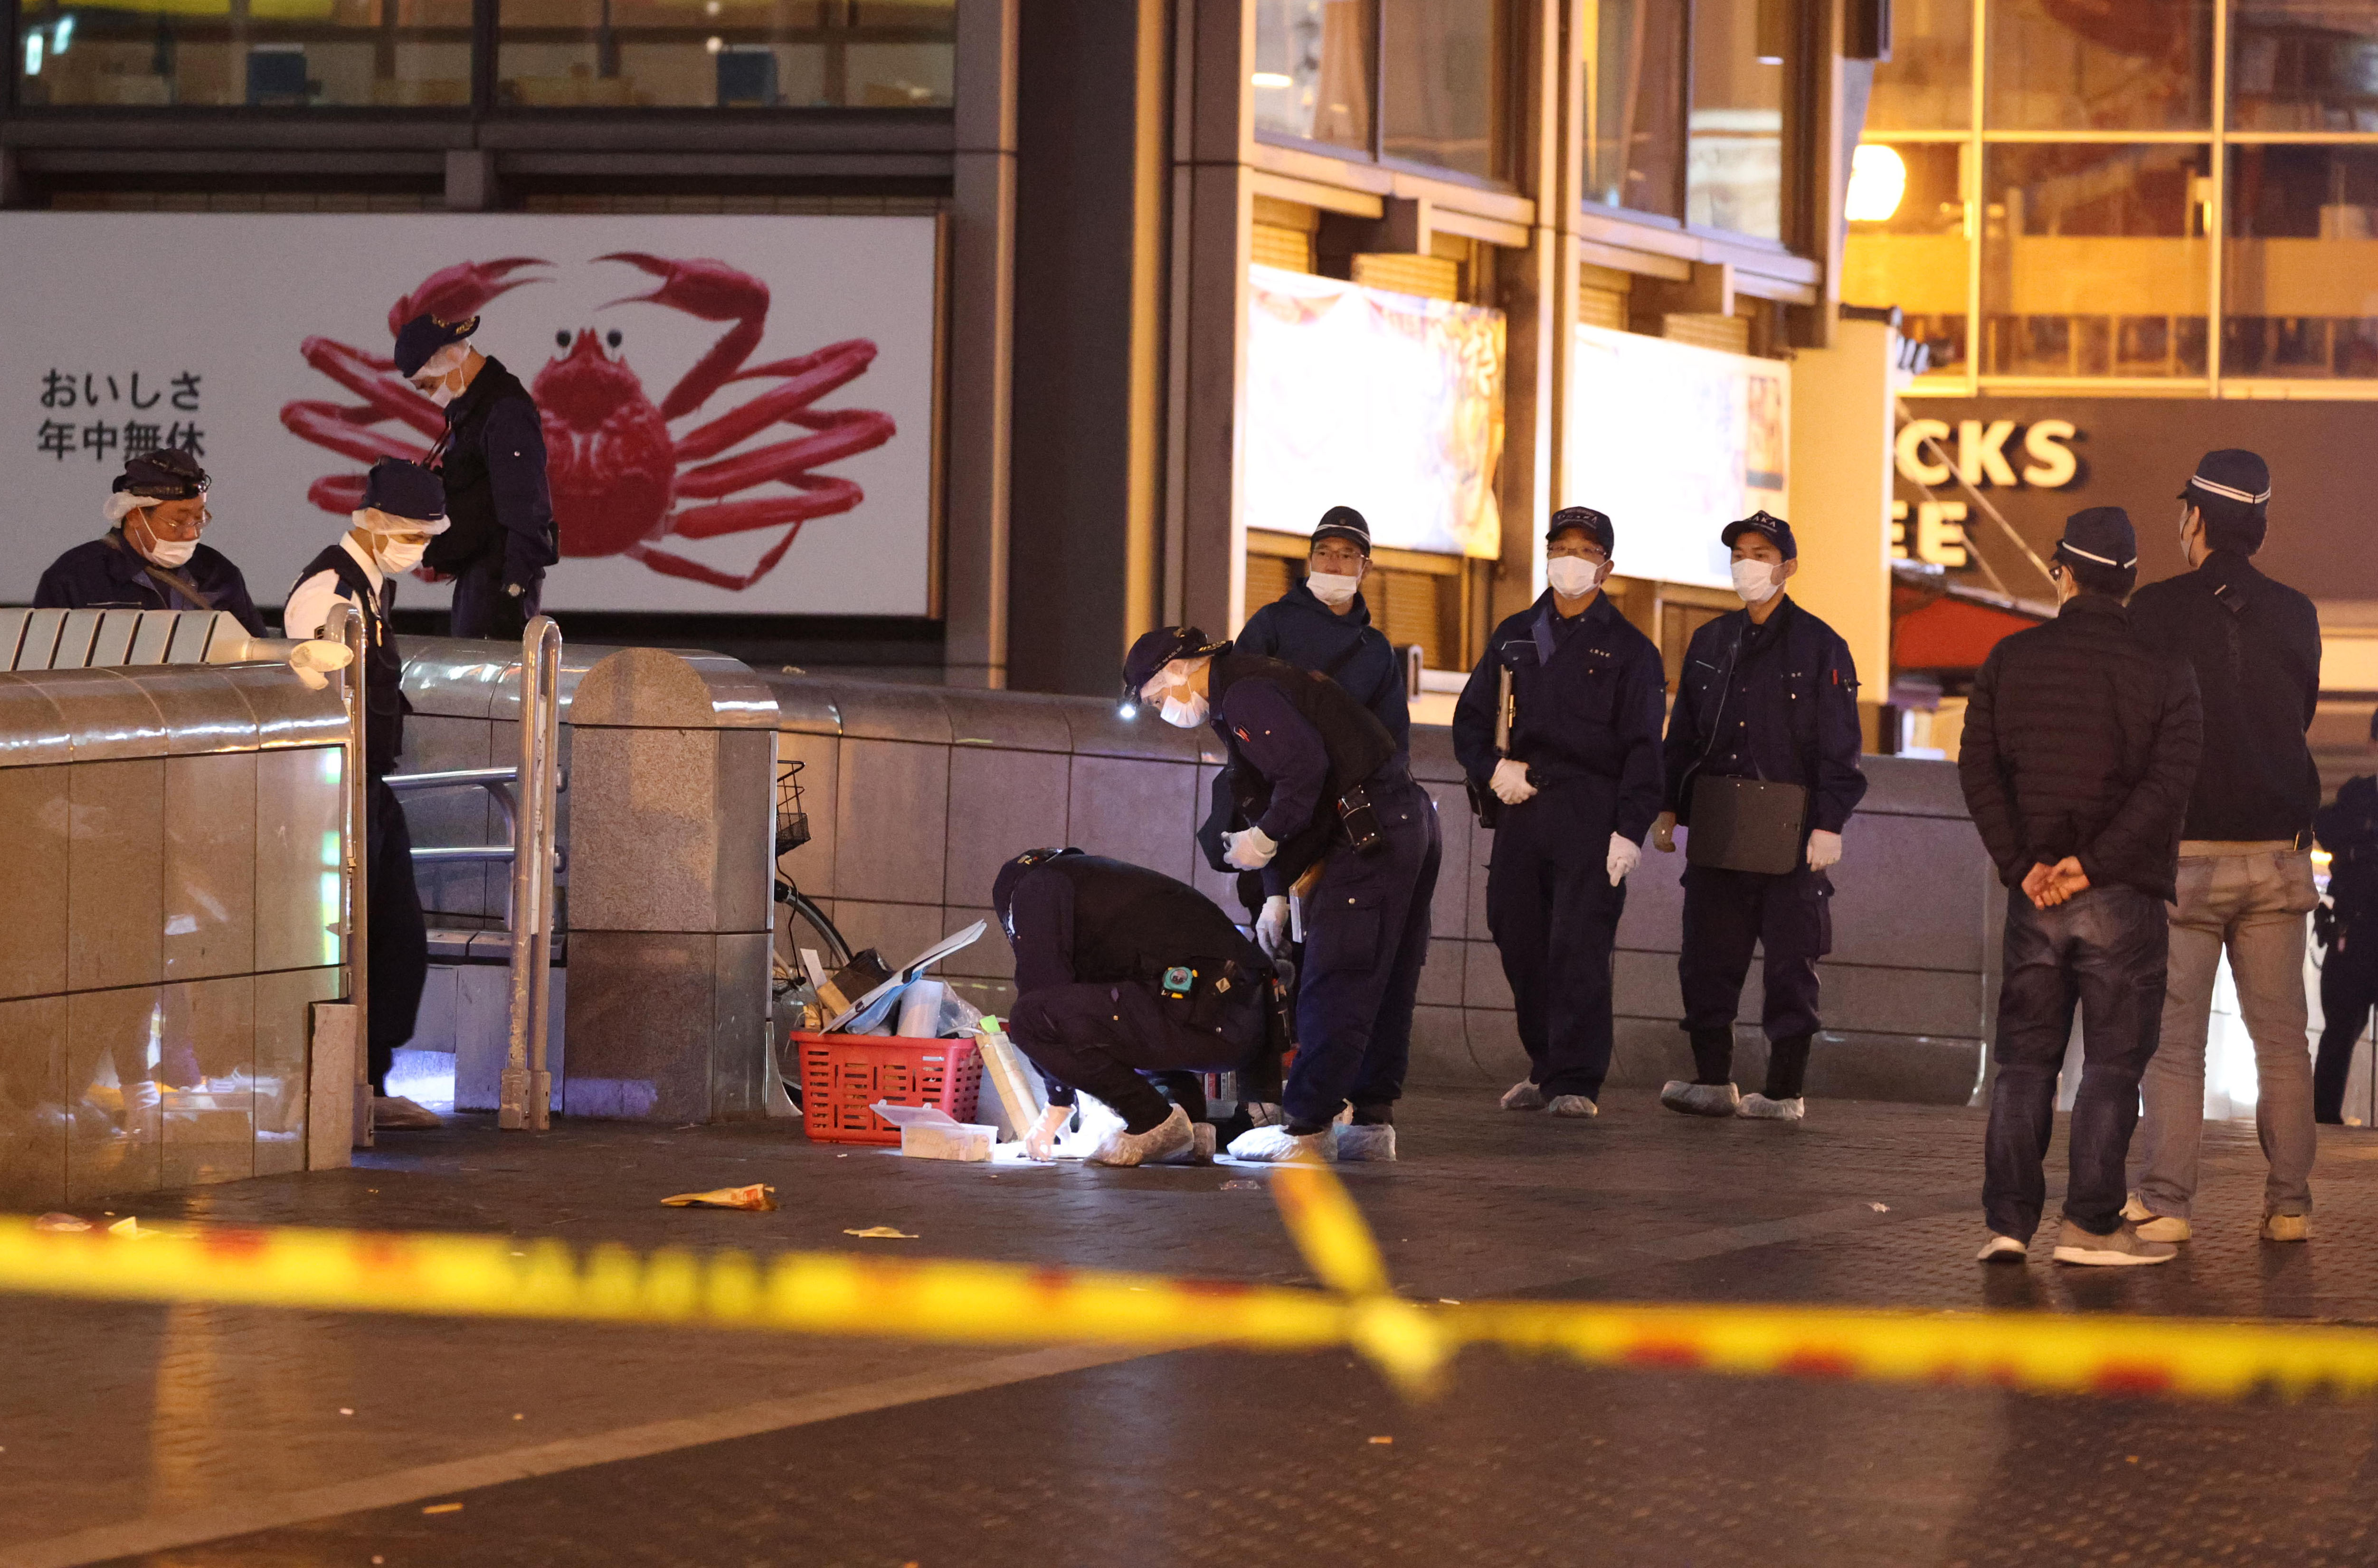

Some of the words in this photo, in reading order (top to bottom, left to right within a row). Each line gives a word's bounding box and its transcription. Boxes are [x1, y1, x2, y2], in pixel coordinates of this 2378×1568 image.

[41, 368, 201, 410] おいしさ
[38, 418, 204, 461] 年中無休
